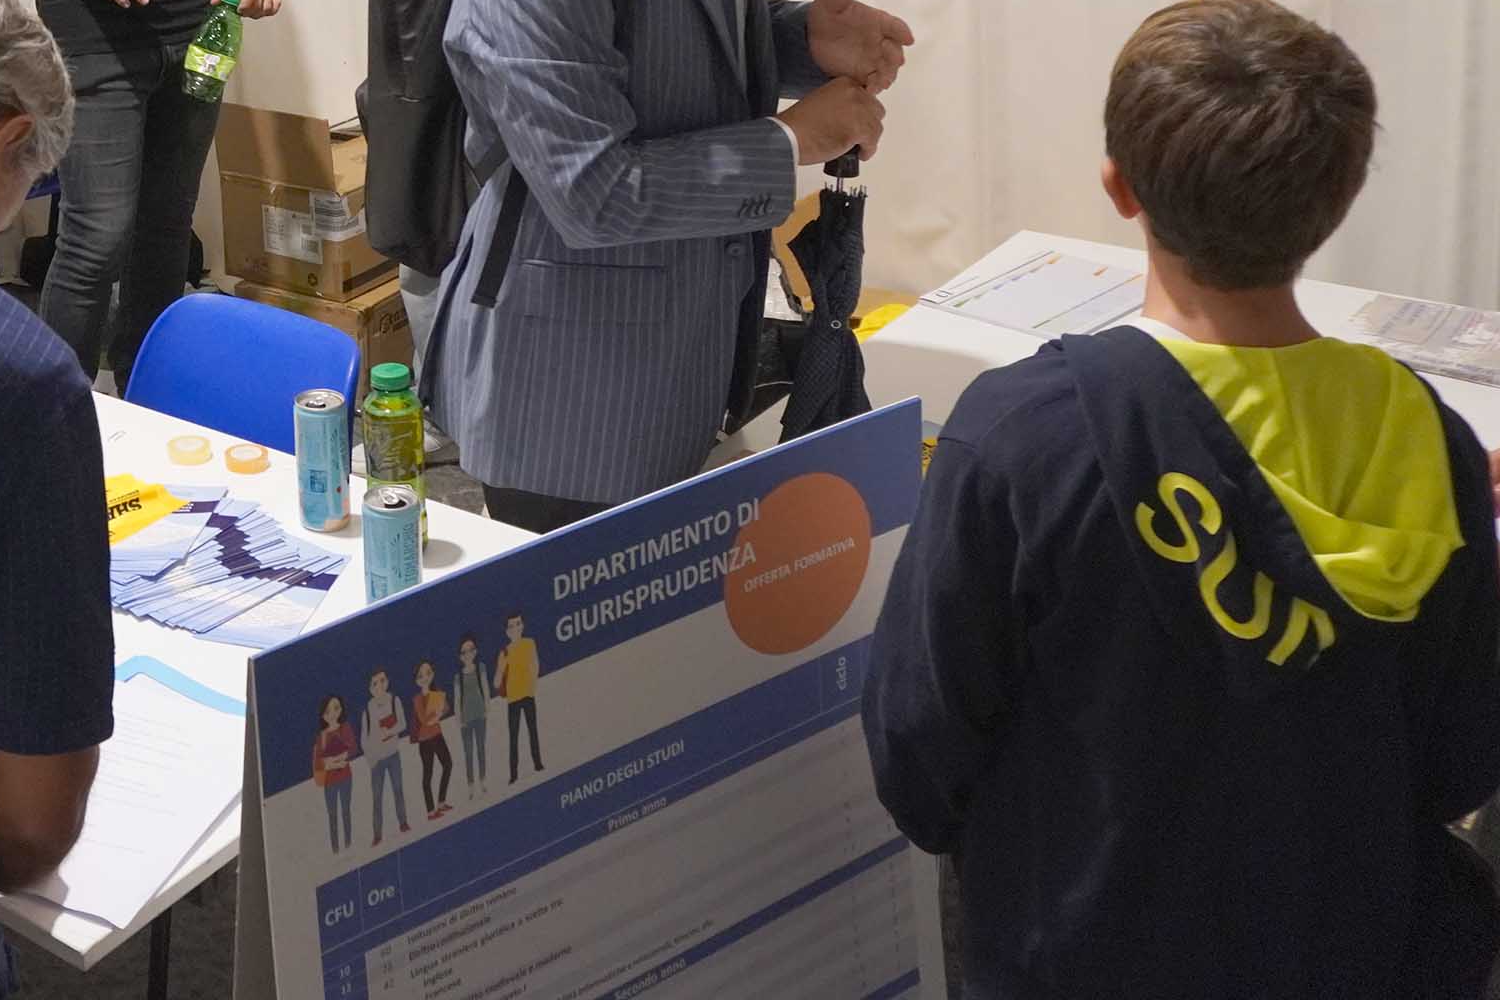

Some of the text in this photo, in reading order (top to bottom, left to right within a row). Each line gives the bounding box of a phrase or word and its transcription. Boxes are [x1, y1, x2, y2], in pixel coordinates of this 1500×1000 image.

[553, 497, 760, 601] DIPARTIMENTO DI
[743, 536, 856, 593] OFFERTA FORMATIVA
[555, 541, 757, 642] GIURISPRUDENZA
[836, 656, 848, 691] ciclo
[560, 738, 685, 809] PIANO DEGLI STUDI
[607, 796, 667, 832] Primo anno
[324, 900, 355, 926] CFU
[367, 885, 395, 906] Ore
[613, 973, 659, 1000] Secondo
[660, 957, 686, 978] anno
